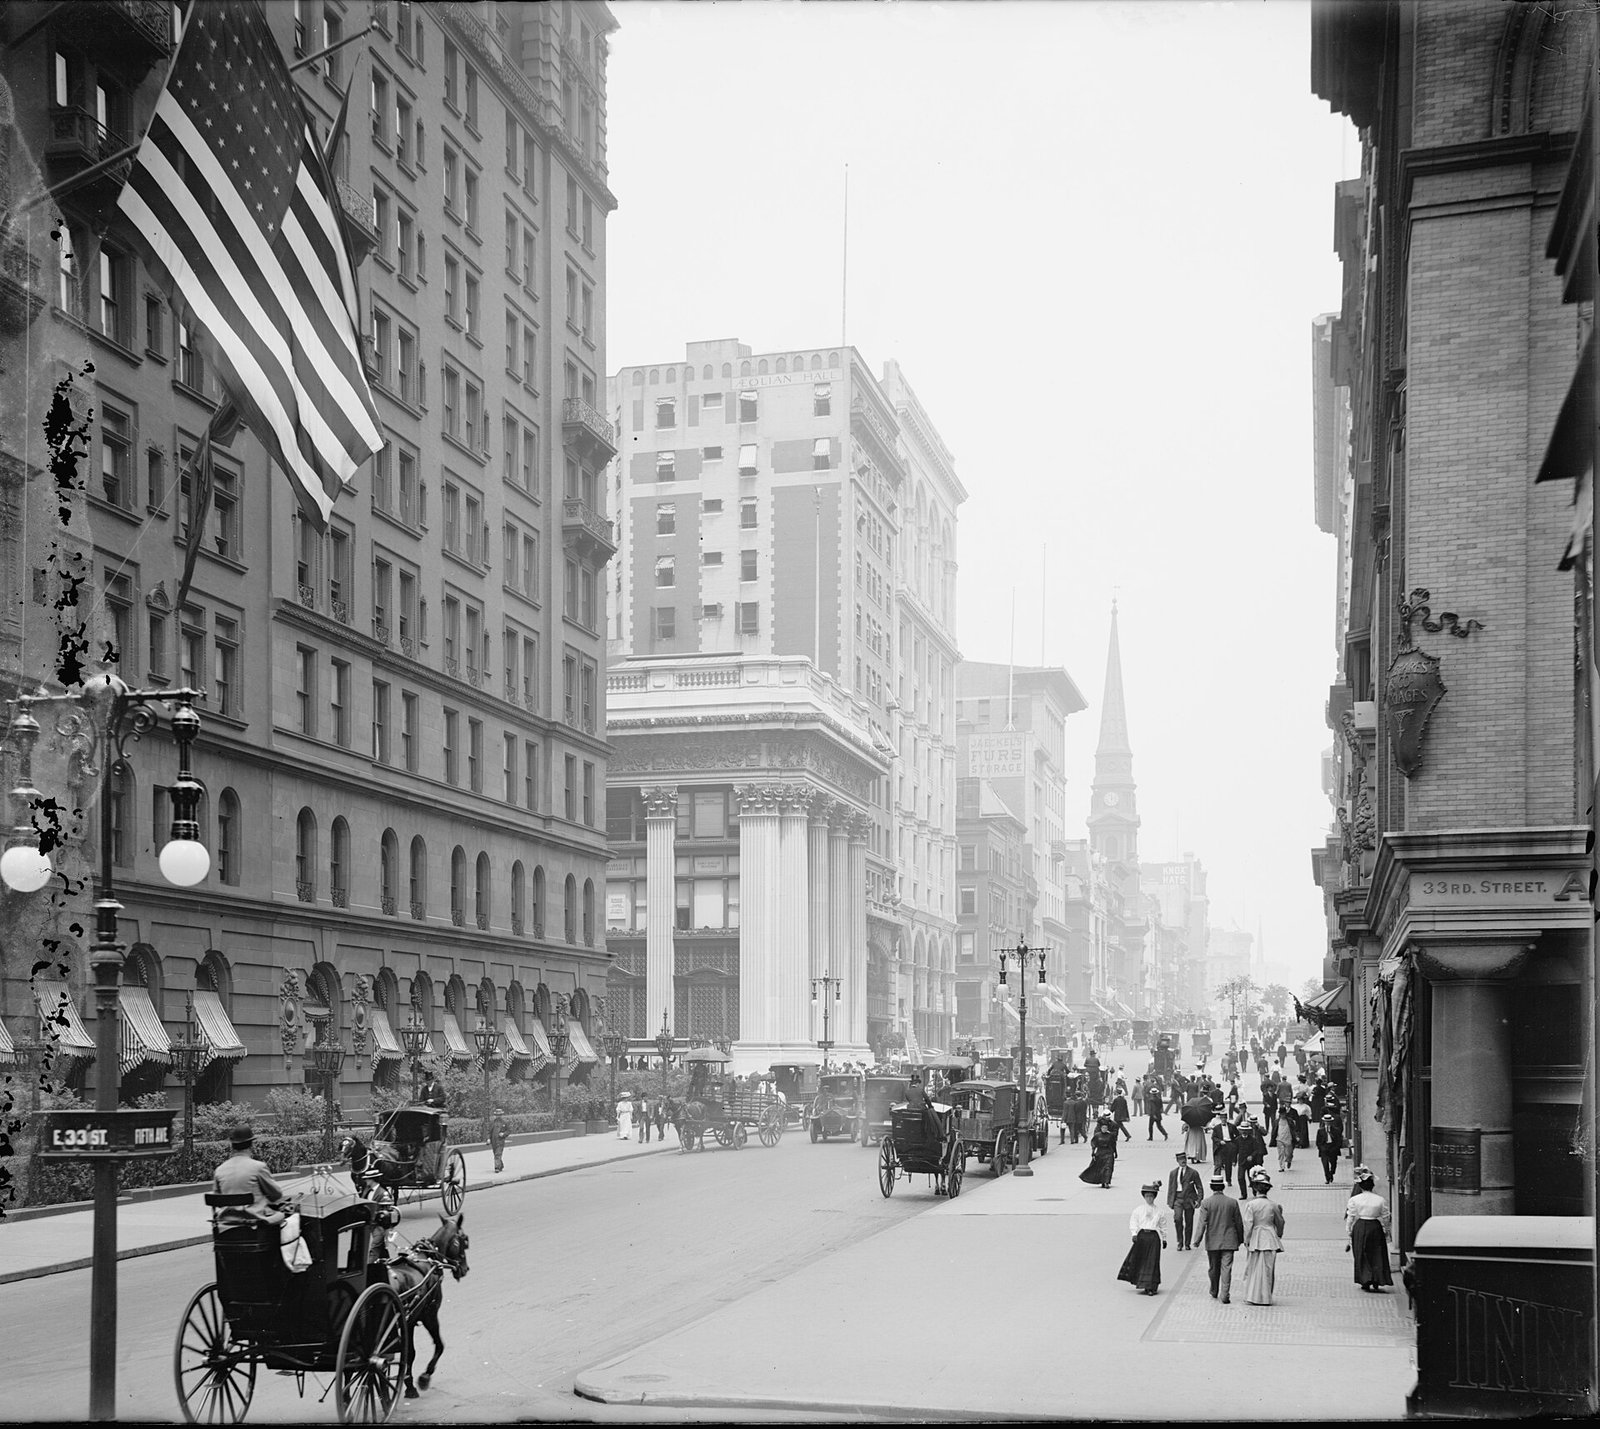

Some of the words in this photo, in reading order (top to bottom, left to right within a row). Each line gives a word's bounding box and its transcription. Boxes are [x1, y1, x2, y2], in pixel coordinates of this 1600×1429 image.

[803, 370, 838, 382] HALL
[970, 749, 1022, 762] FURS
[1163, 866, 1188, 875] KNOX
[1162, 875, 1186, 885] HATS
[134, 1127, 155, 1145] FIFTH
